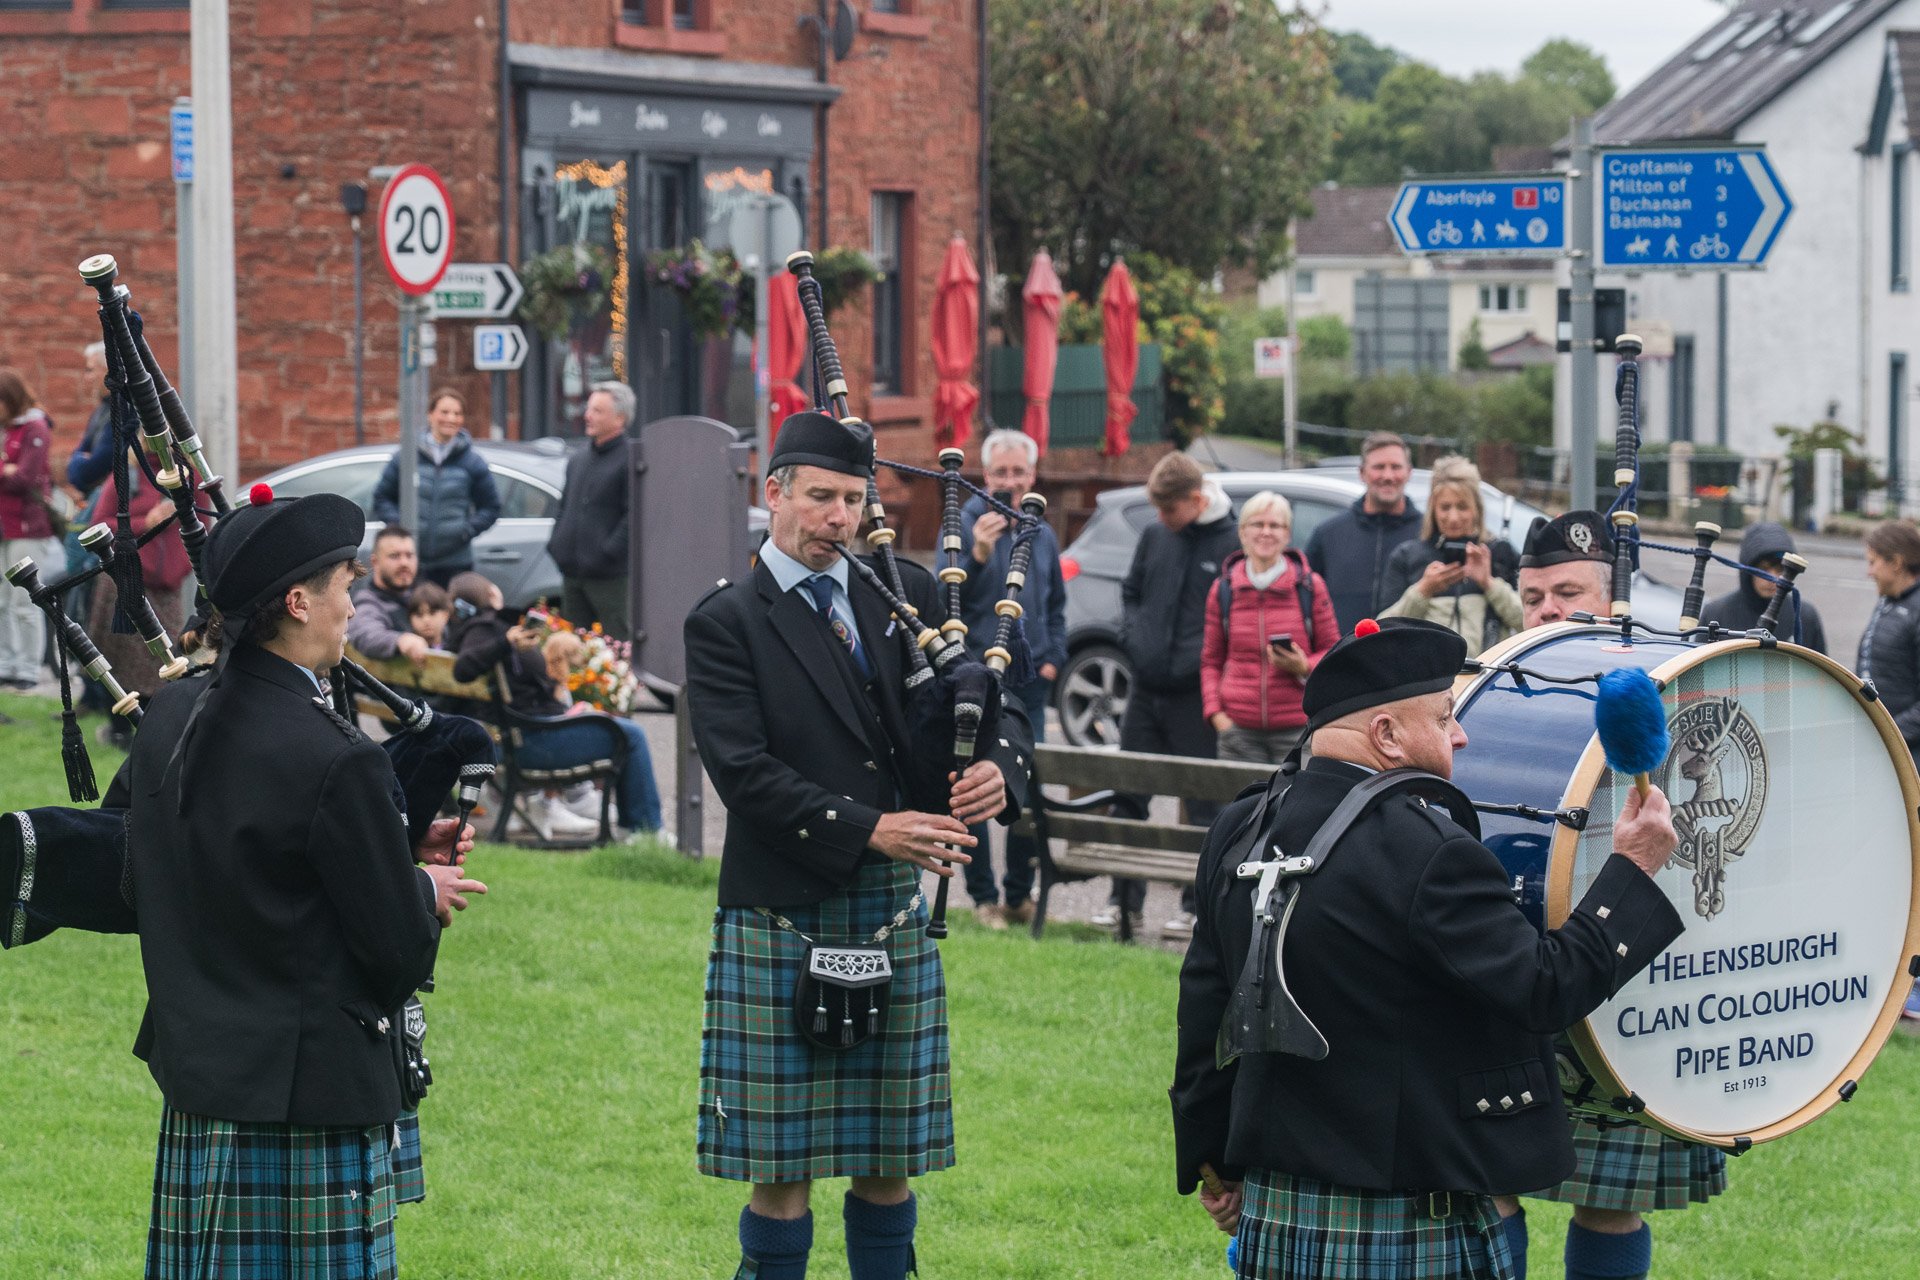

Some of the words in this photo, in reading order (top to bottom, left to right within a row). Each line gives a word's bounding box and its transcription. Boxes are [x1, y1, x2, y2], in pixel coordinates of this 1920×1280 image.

[1608, 158, 1693, 176] Croftamie
[1609, 177, 1664, 194] Milton
[1668, 176, 1687, 194] of
[1715, 184, 1728, 202] 3
[1425, 188, 1497, 208] Aberfoyle
[1542, 186, 1561, 203] 10
[1609, 195, 1692, 213] Buchanan
[394, 205, 442, 254] 20
[1609, 212, 1683, 229] Balmaha
[1715, 211, 1728, 229] 5
[1735, 718, 1760, 760] PUIS
[1648, 932, 1838, 985] HELENSBURGH
[1617, 1003, 1690, 1038] CLAN
[1697, 975, 1869, 1025] COLQUHOUN
[1676, 1045, 1730, 1078] PIPE
[1739, 1032, 1814, 1067] BAND
[1724, 1081, 1739, 1093] Est
[1742, 1076, 1767, 1090] 1913
